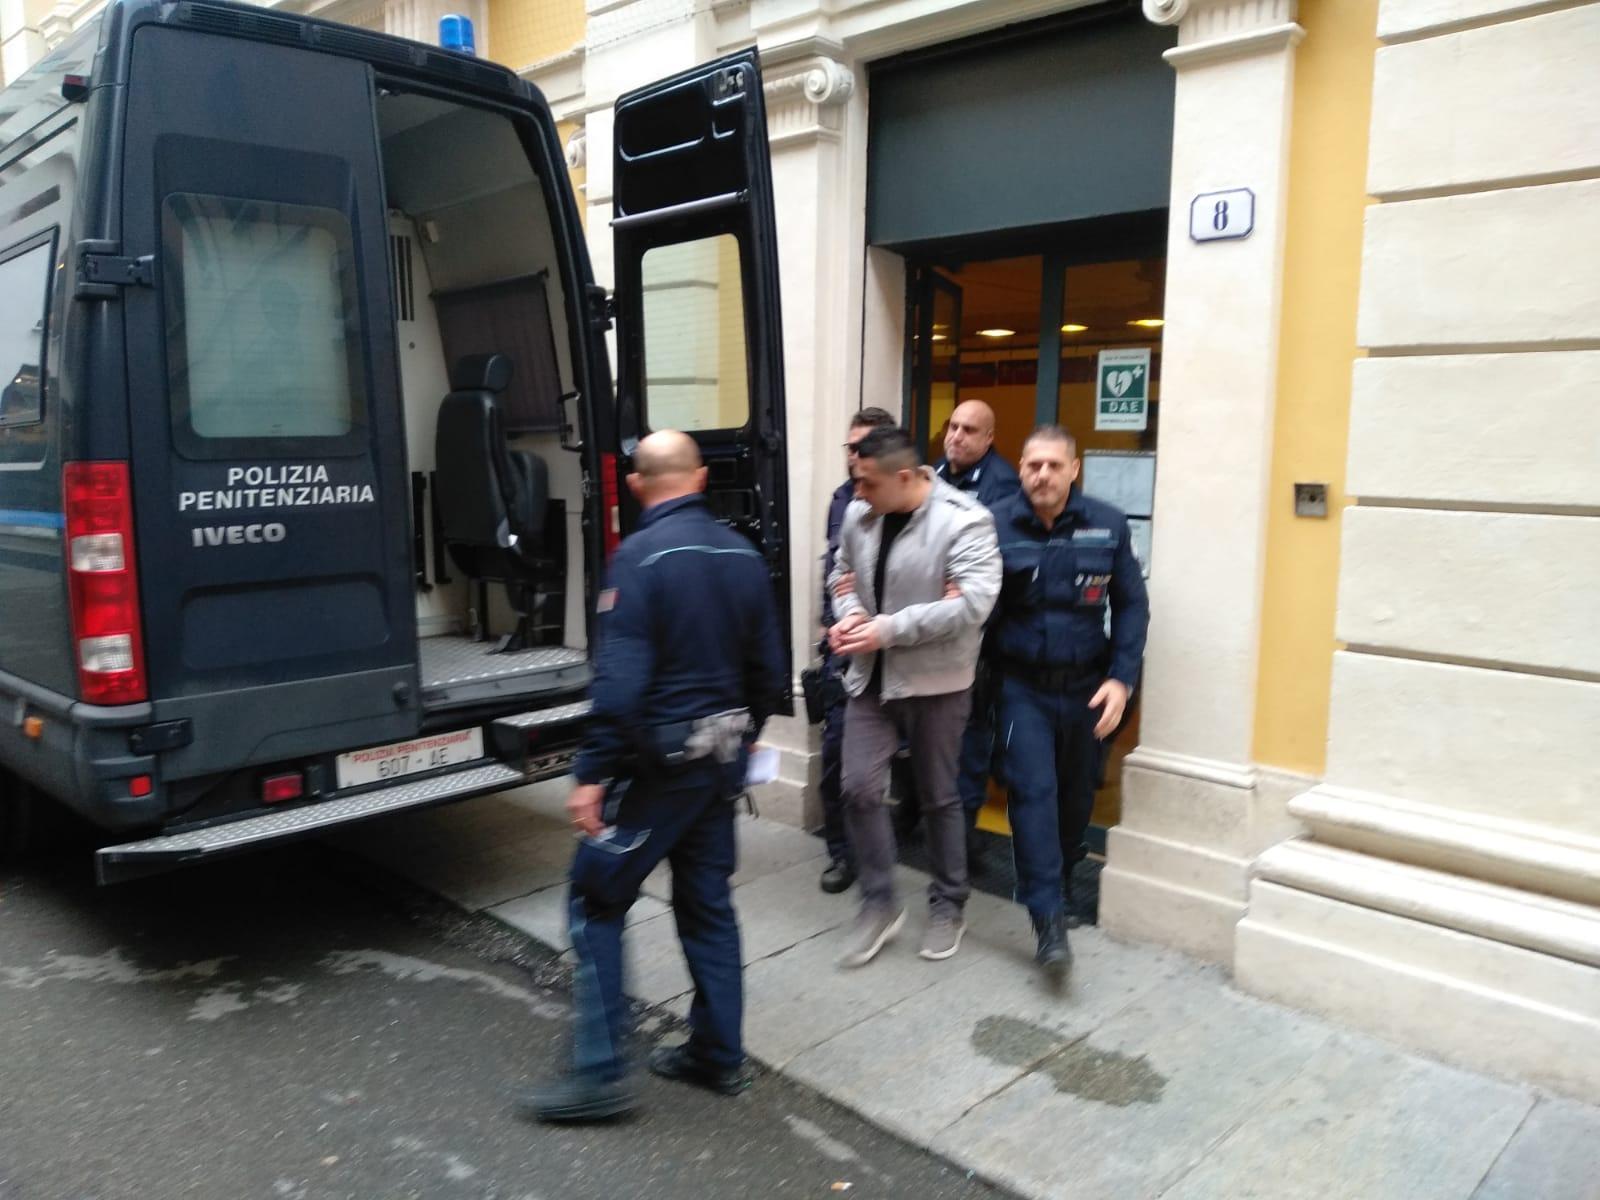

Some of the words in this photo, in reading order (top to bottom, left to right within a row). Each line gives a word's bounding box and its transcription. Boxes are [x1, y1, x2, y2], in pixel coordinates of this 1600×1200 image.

[1213, 199, 1229, 231] 8
[1108, 401, 1139, 413] DAE
[227, 465, 329, 486] POLIZIA
[178, 485, 375, 511] PENITENZIARIA
[192, 522, 286, 547] IVECO
[352, 749, 394, 763] POLIZIA
[377, 755, 410, 777] 607
[430, 747, 449, 767] AE
